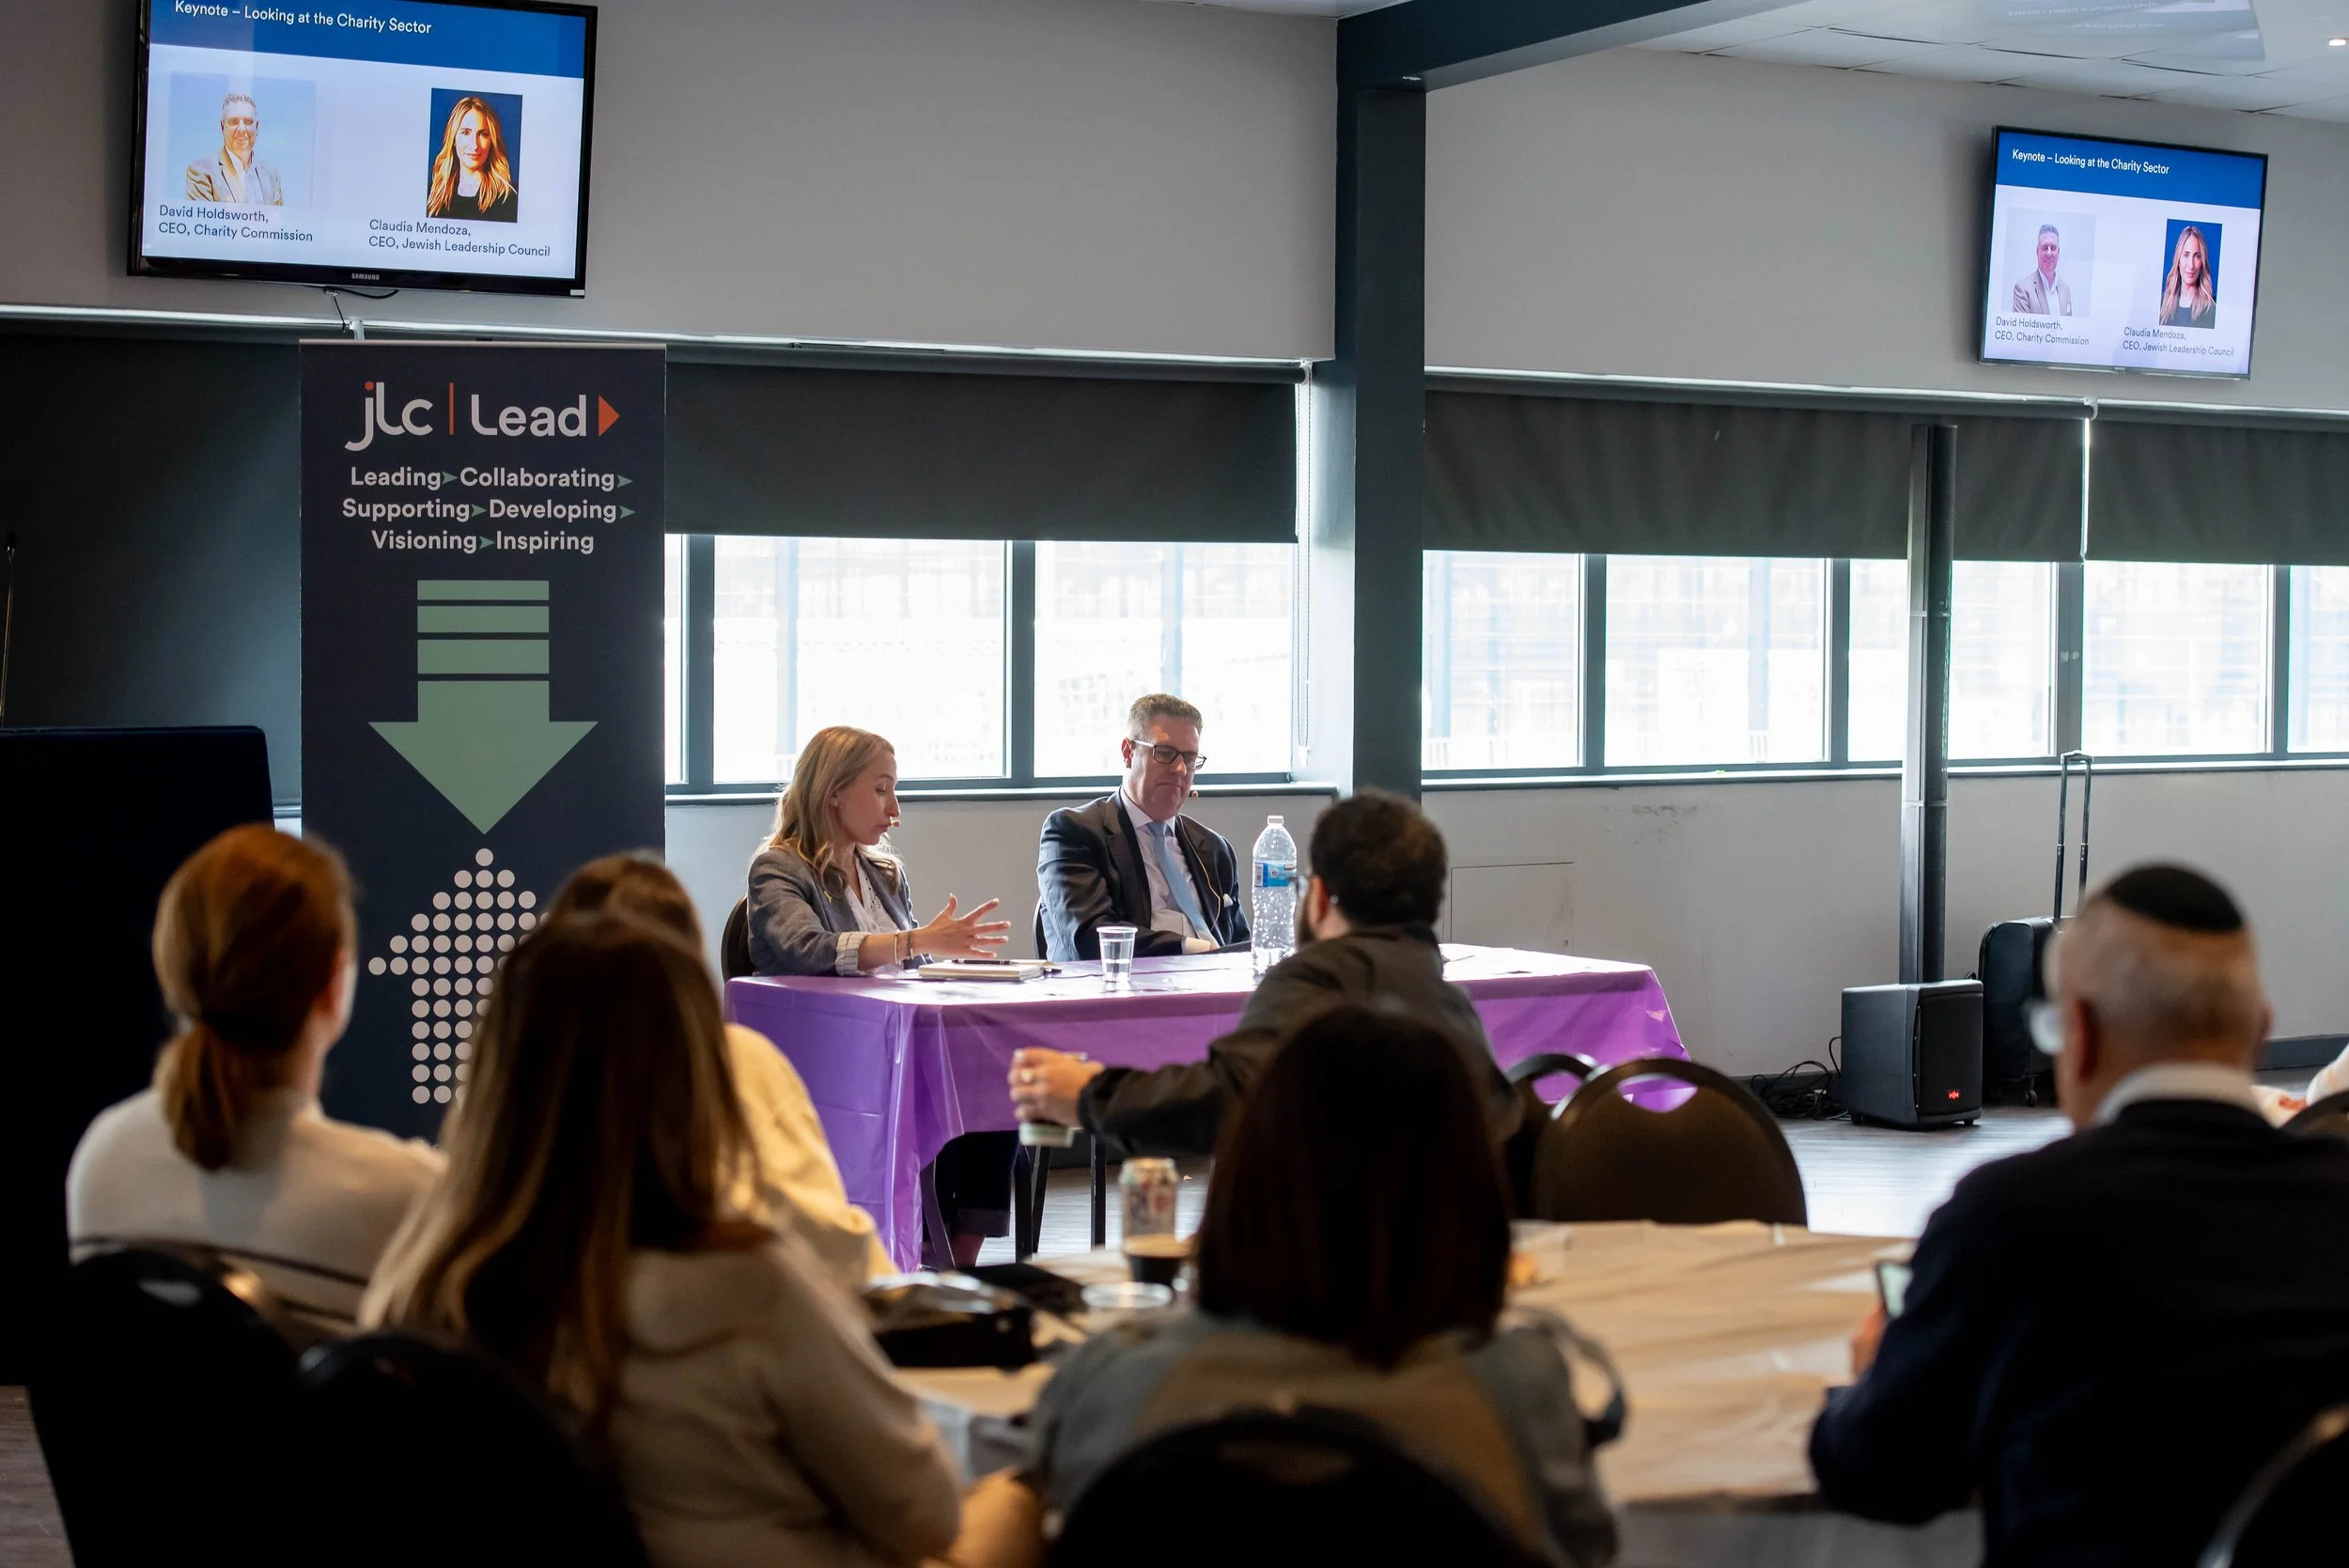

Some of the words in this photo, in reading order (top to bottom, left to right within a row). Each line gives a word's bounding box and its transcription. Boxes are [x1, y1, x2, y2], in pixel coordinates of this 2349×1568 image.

[176, 0, 228, 17] Keynote
[245, 7, 294, 24] Looking
[298, 14, 310, 23] at
[314, 12, 334, 25] the
[337, 14, 385, 32] Charity
[389, 18, 431, 33] Sector
[2013, 148, 2045, 163] Keynote
[2055, 153, 2085, 167] Looking
[2088, 159, 2095, 167] at
[2097, 158, 2109, 168] the
[2112, 159, 2140, 173] Charity
[2143, 163, 2170, 174] Sector
[160, 205, 193, 217] David
[197, 207, 268, 223] Holdsworth,
[159, 223, 190, 235] CEO,
[194, 225, 237, 240] Charity
[241, 227, 313, 241] Commission
[370, 219, 412, 232] Claudia
[416, 223, 471, 237] Mendoza,
[368, 236, 398, 249] CEO,
[402, 238, 441, 251] Jewish
[445, 241, 505, 256] Leadership
[508, 244, 551, 256] Council
[1996, 317, 2016, 326] David
[2019, 318, 2062, 330] Holdsworth,
[1995, 331, 2014, 341] CEO,
[2016, 332, 2043, 344] Charity
[2046, 334, 2089, 346] Commission
[2124, 327, 2150, 336] Claudia
[2153, 329, 2186, 340] Mendoza,
[2123, 341, 2140, 350] CEO,
[2143, 342, 2167, 352] Jewish
[2170, 344, 2206, 355] Leadership
[2208, 347, 2234, 356] Council
[345, 381, 433, 452] jlc
[471, 395, 586, 437] Lead
[351, 467, 441, 490] Leading
[460, 467, 614, 491] Collaborating
[342, 499, 470, 522] Supporting
[490, 499, 616, 522] Developing
[372, 530, 476, 554] Visioning
[497, 531, 593, 554] Inspiring
